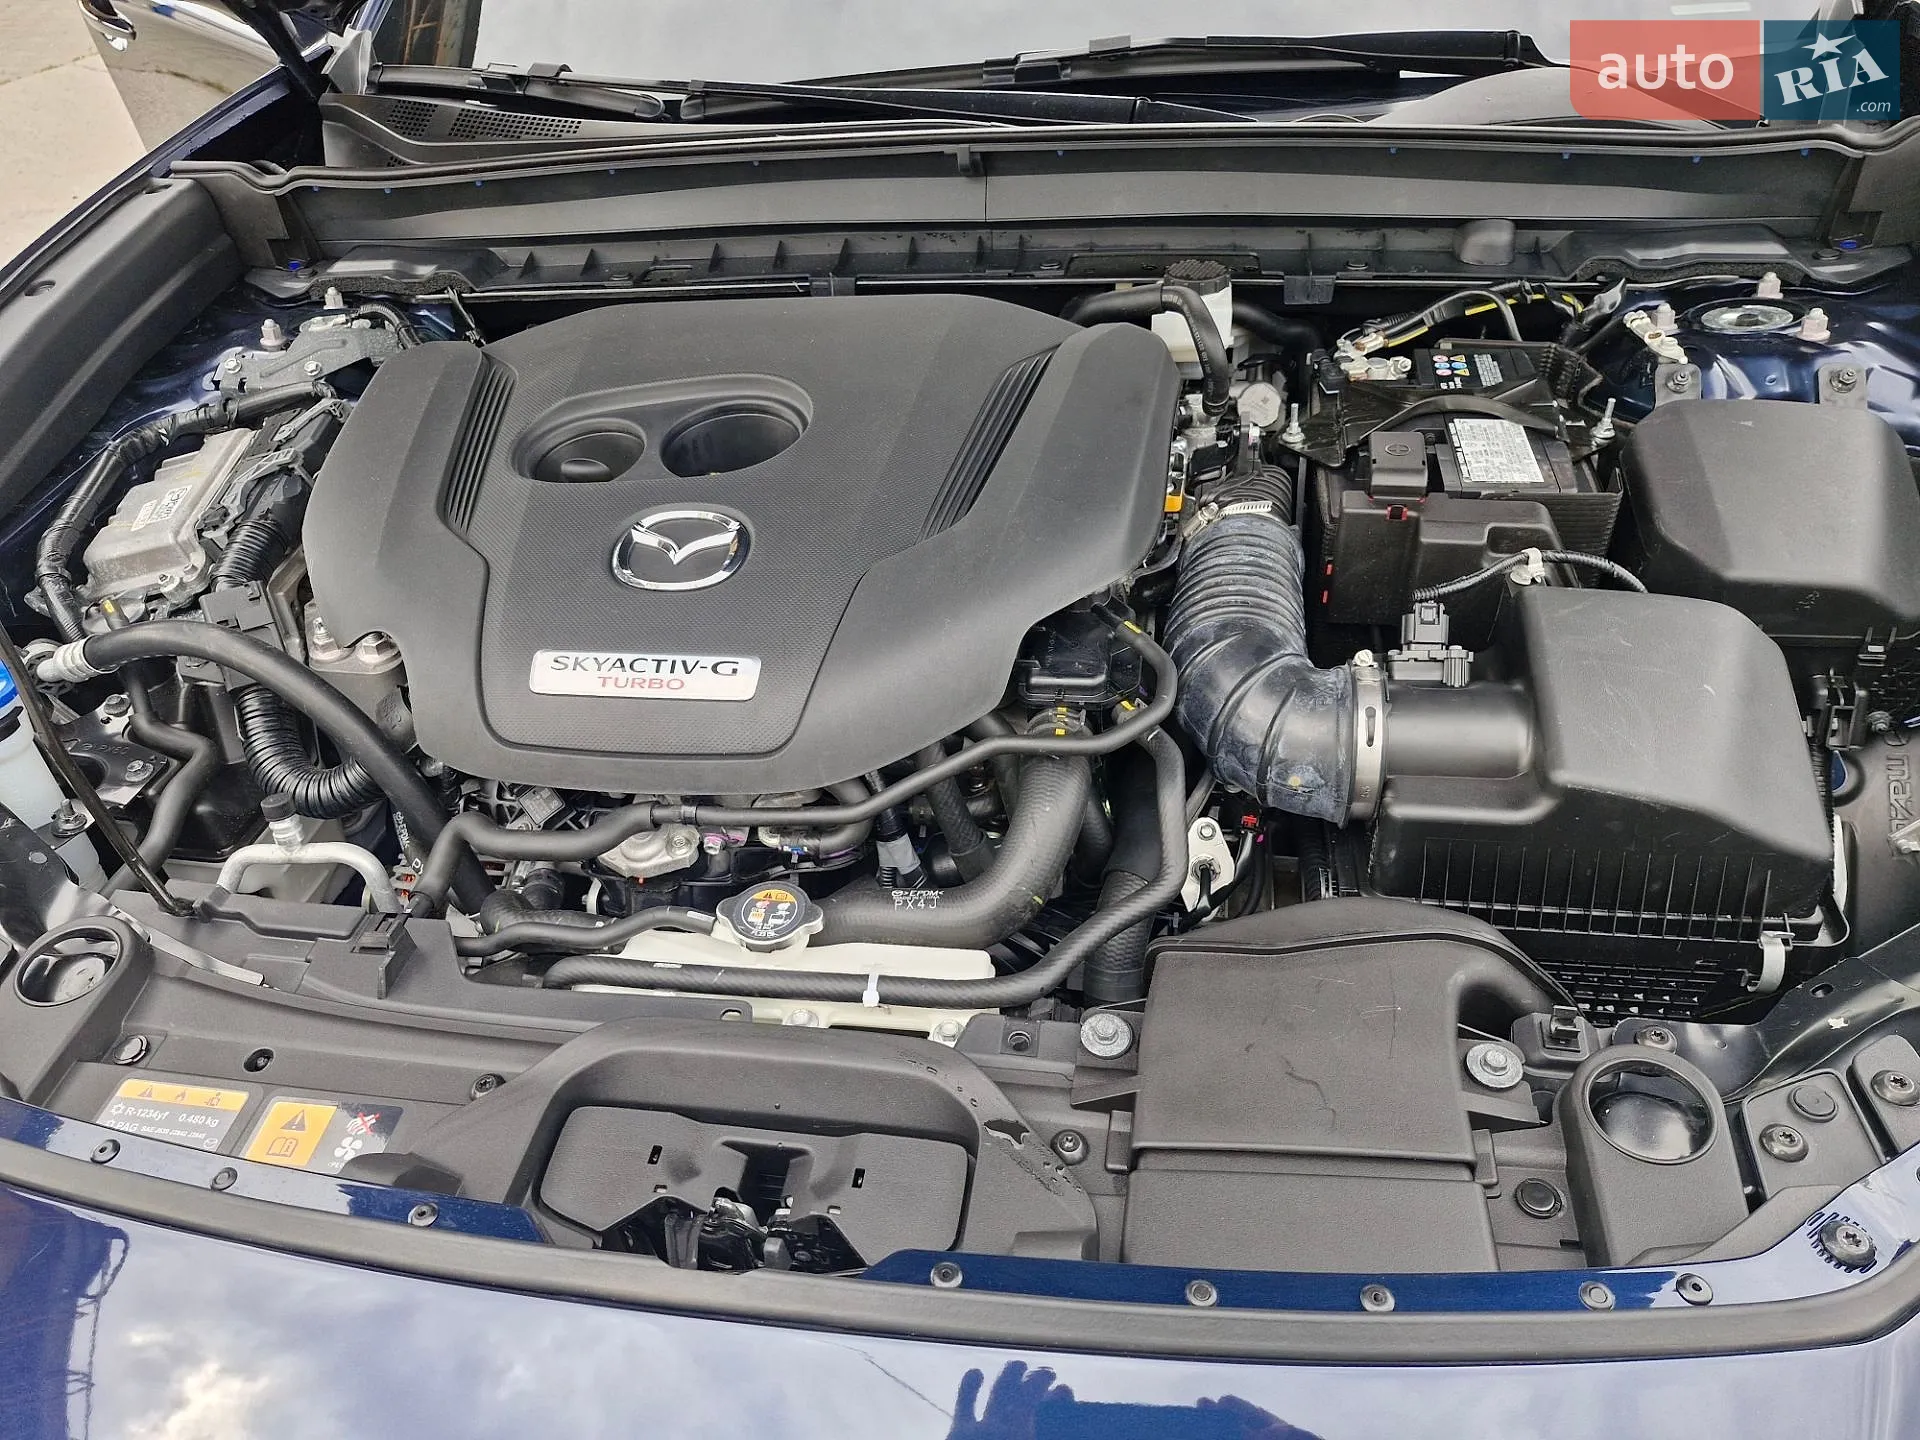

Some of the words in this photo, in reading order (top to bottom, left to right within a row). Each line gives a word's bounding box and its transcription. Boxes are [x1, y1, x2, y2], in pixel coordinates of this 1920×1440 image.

[550, 656, 739, 676] SKYACTIV-G
[598, 676, 685, 690] TURBO
[125, 1106, 169, 1121] R-1234yf
[206, 1116, 219, 1127] kg
[117, 1121, 137, 1133] PAG
